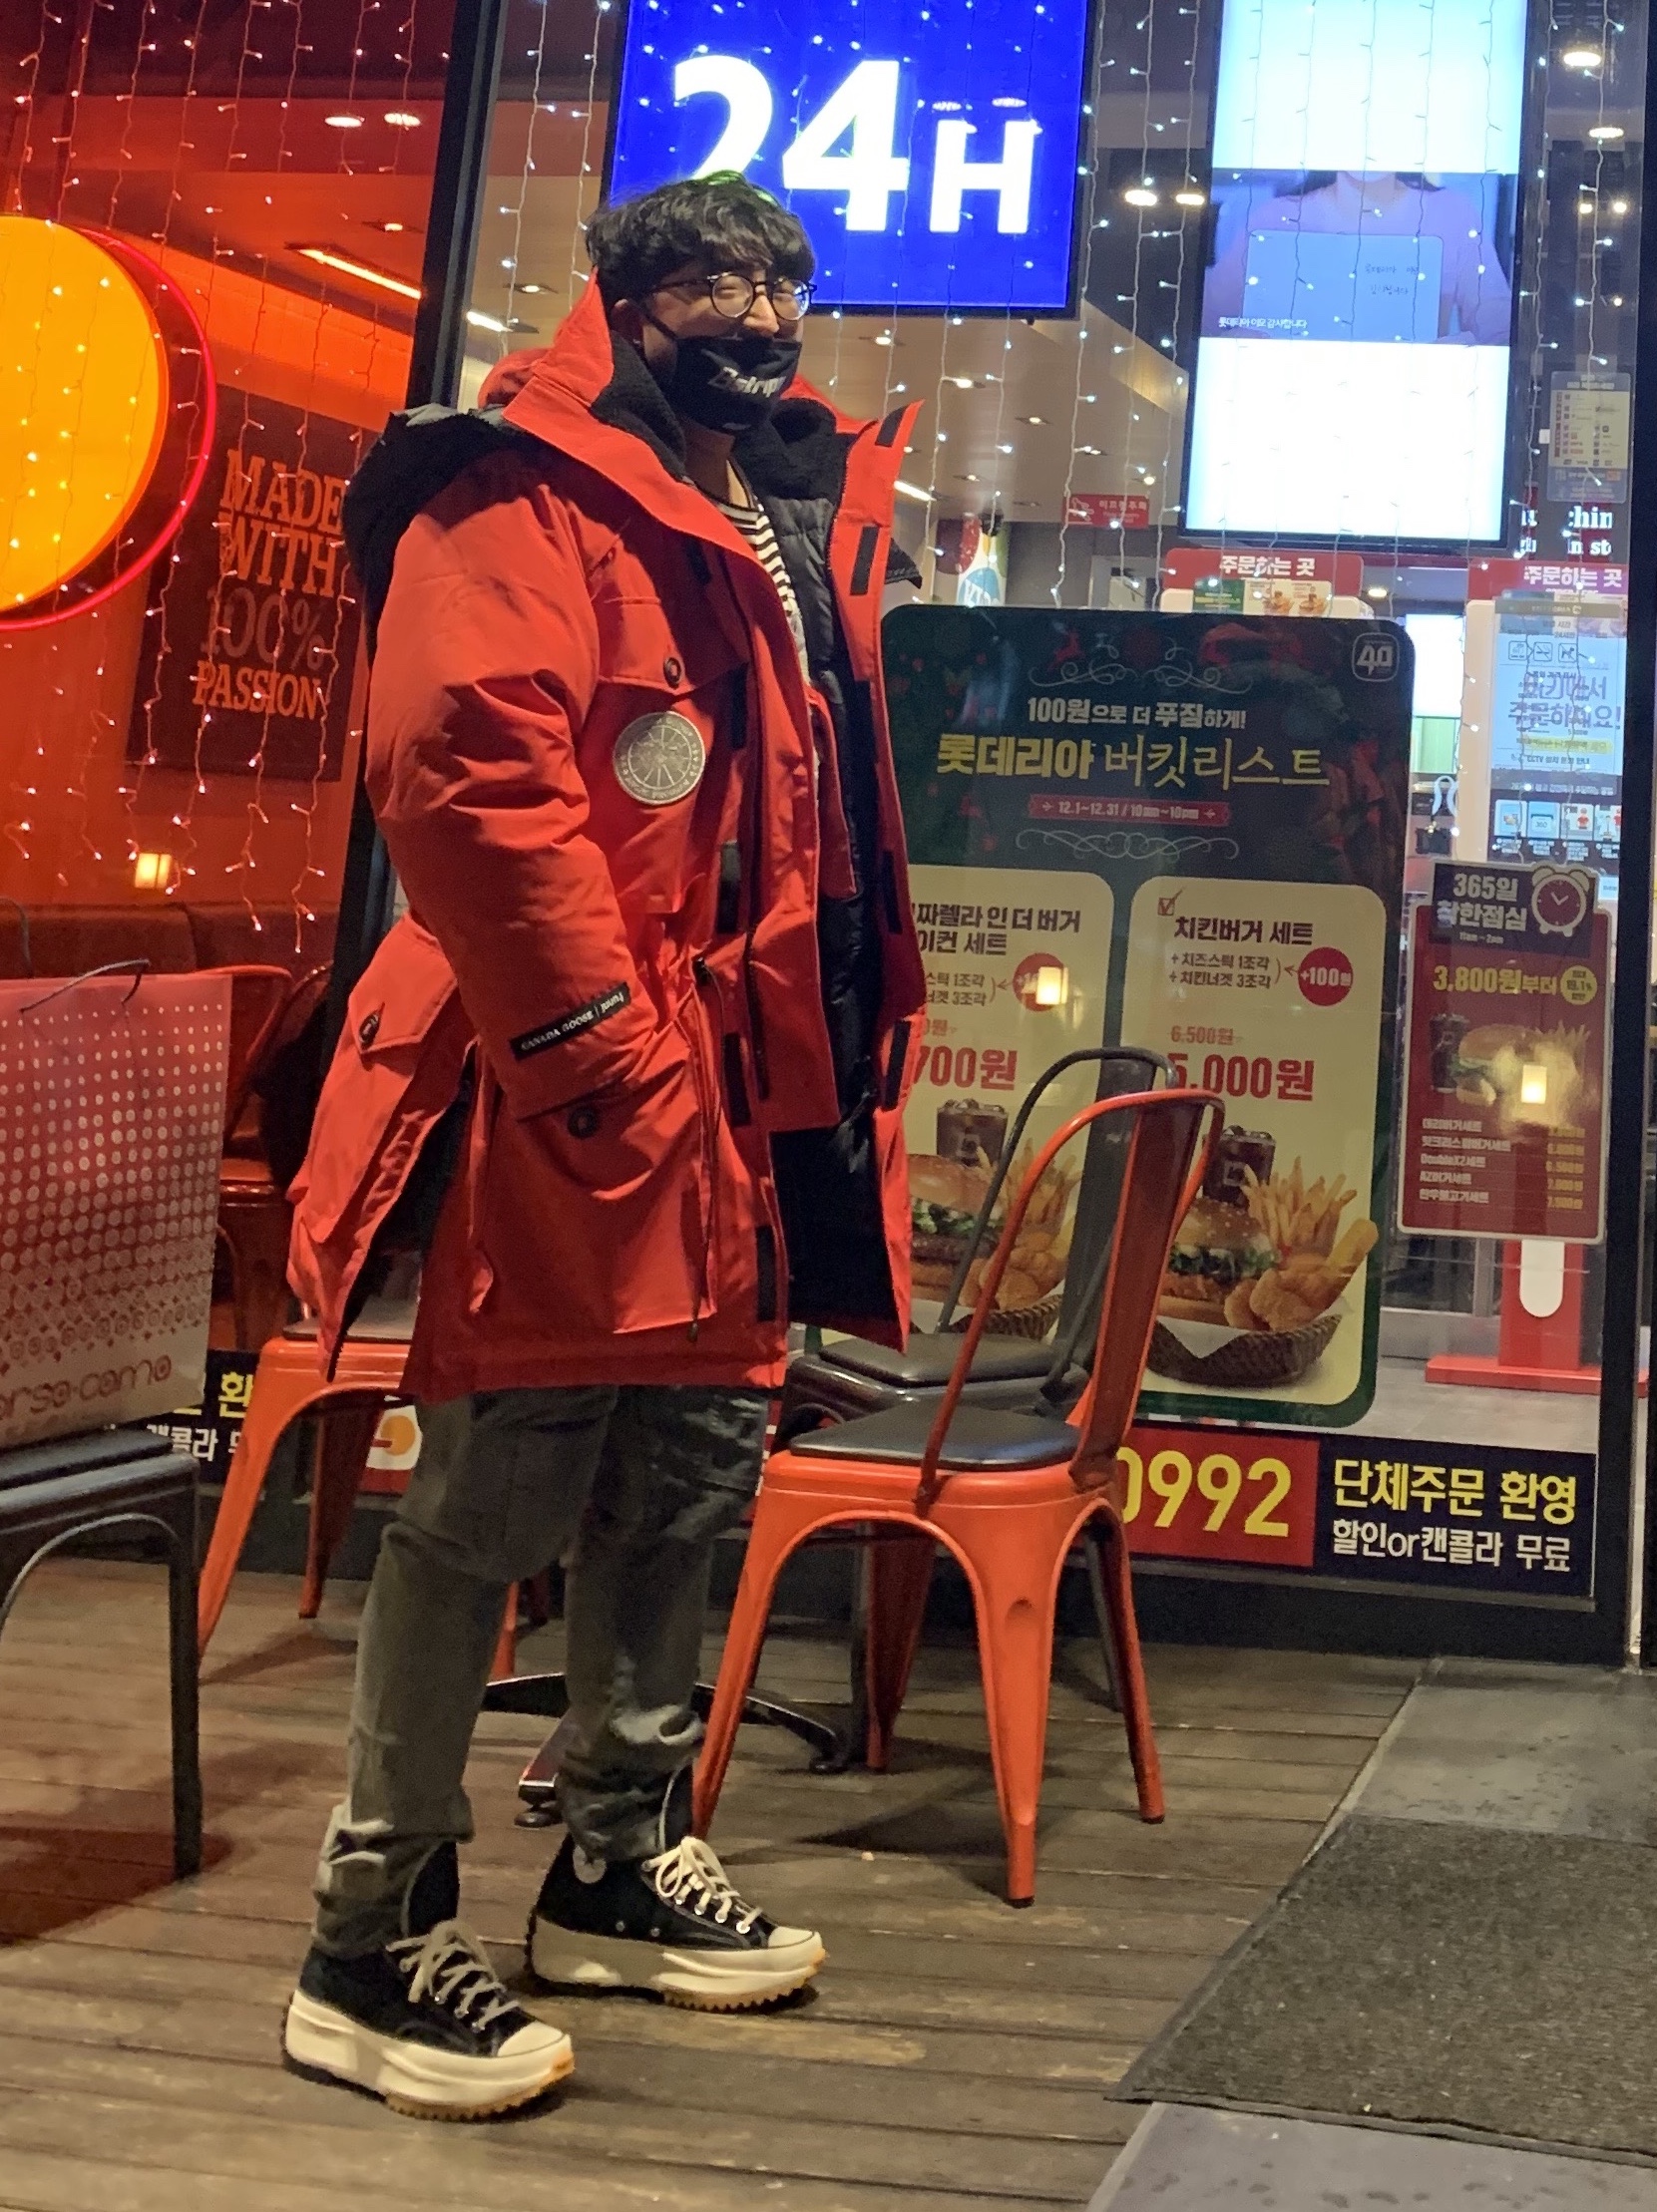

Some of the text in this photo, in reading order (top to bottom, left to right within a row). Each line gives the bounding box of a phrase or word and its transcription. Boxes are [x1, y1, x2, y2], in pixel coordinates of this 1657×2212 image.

[219, 449, 348, 535] MADE
[219, 511, 339, 598] WITH
[1219, 554, 1316, 577] 주문하는 곳
[1523, 565, 1623, 587] 주문하는 곳
[201, 584, 325, 671] 100%
[193, 658, 324, 720] PASSION
[1028, 697, 1247, 729] 100원으로 더 푸짐하게!
[937, 733, 1331, 791] 롯데리아 버킷리스트
[1452, 873, 1519, 903] 365일
[912, 903, 1081, 933] 짜렐라 인 더 버거
[1173, 916, 1314, 945] 치킨버거 세트
[963, 931, 1008, 956] 세트
[1236, 973, 1272, 989] 3조각
[1433, 964, 1558, 995] 3.800원부터
[521, 1028, 562, 1050] CANADA
[562, 1010, 595, 1031] GOOSE
[1167, 1052, 1315, 1101] 5.000원
[1334, 1459, 1577, 1525] 단체주문 환영
[1333, 1518, 1571, 1573] 할인or캔콜라 무료
